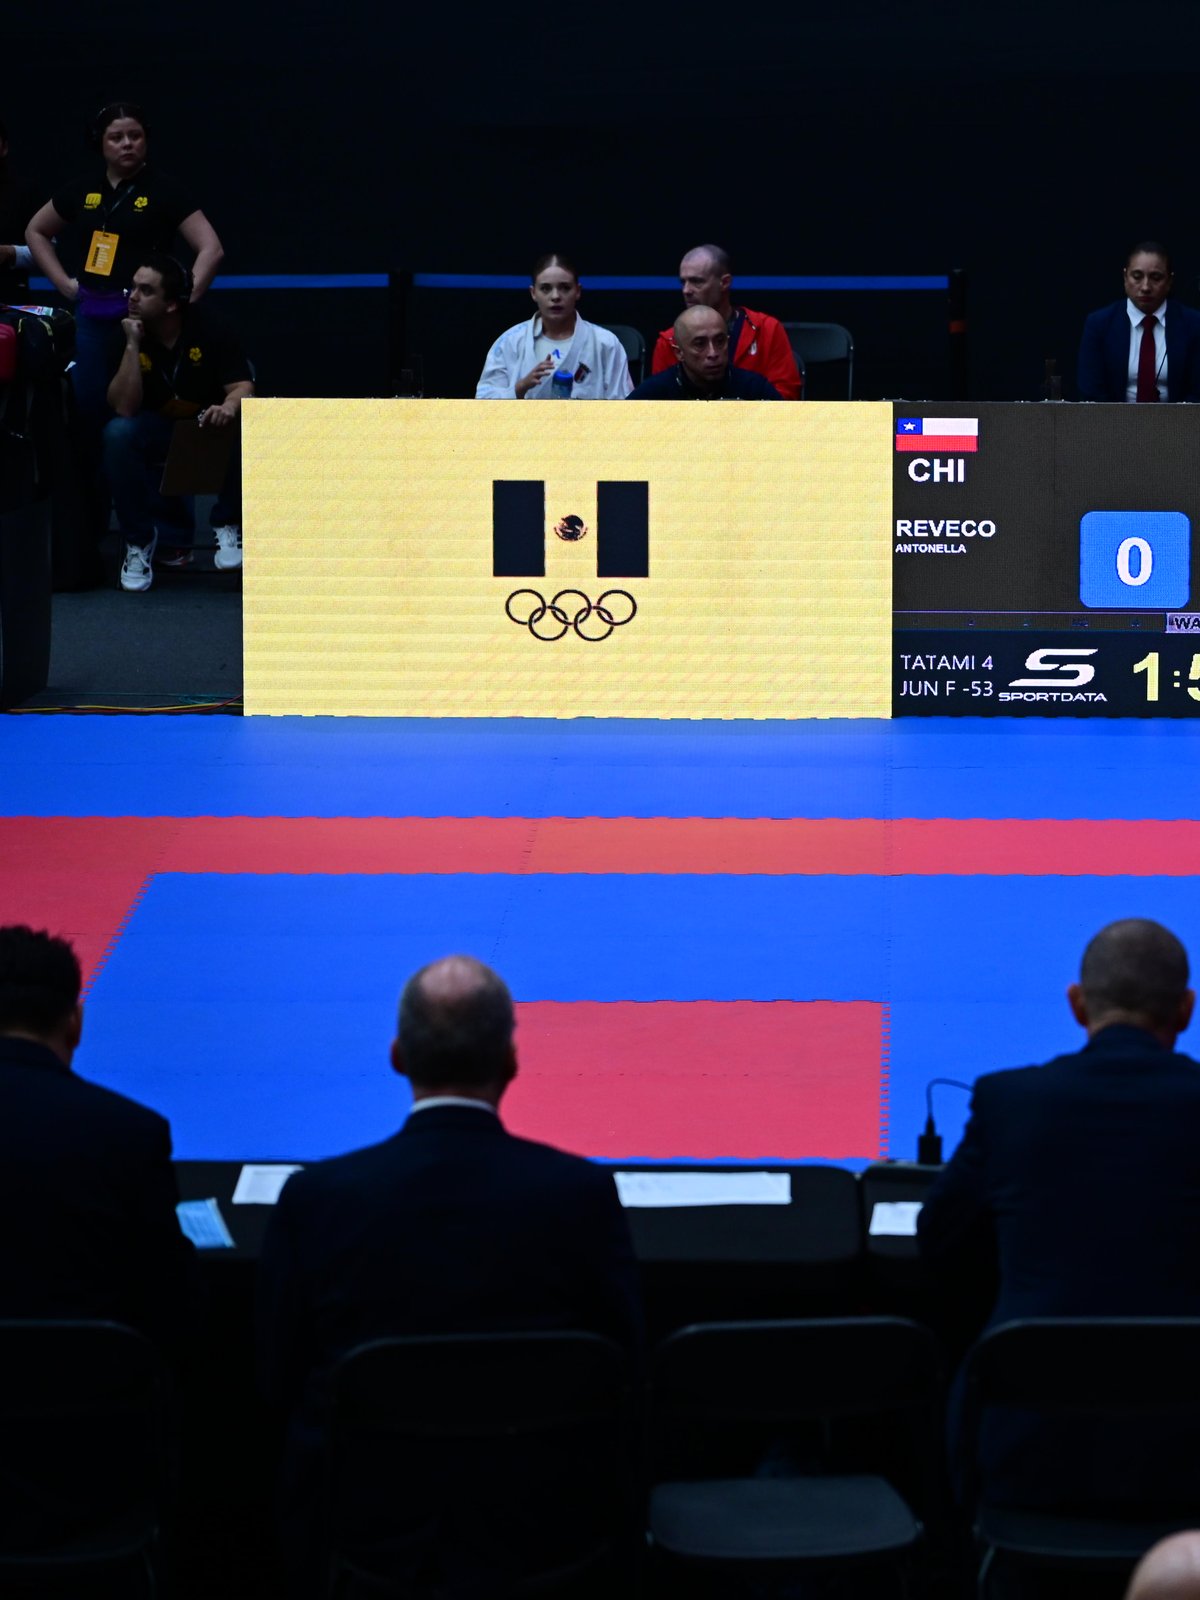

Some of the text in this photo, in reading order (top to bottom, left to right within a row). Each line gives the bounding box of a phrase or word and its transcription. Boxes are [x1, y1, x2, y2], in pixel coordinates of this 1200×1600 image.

[908, 458, 965, 482] CHI
[896, 519, 996, 537] REVECO
[895, 543, 967, 553] ANTONELLA
[1116, 536, 1153, 586] 0
[900, 655, 994, 670] TATAMI 4
[900, 681, 994, 696] JUN F -53
[998, 692, 1108, 702] SPORTDATA
